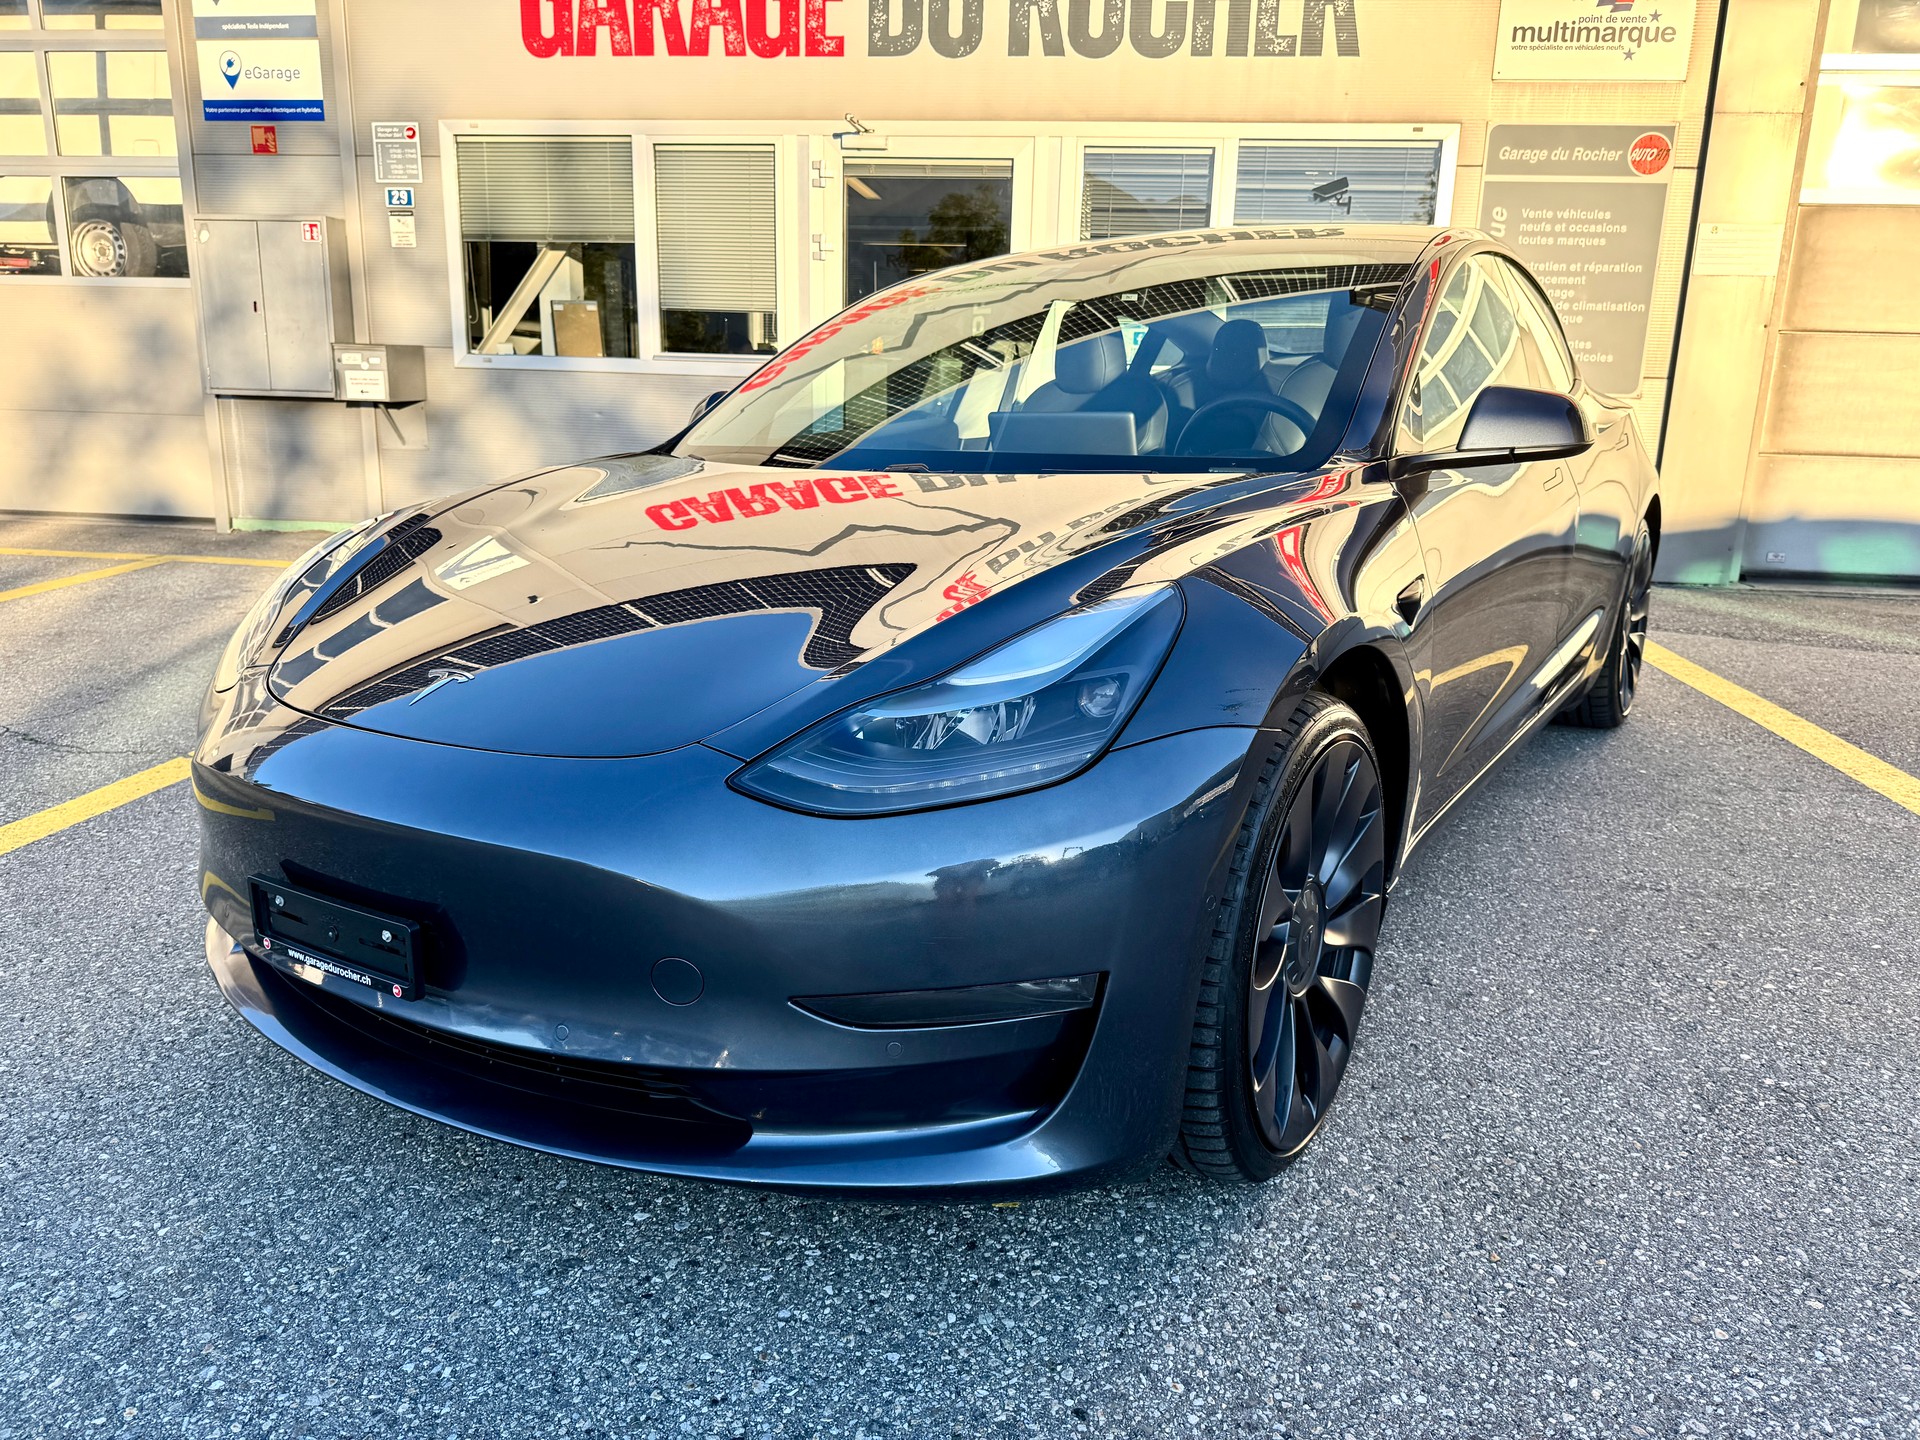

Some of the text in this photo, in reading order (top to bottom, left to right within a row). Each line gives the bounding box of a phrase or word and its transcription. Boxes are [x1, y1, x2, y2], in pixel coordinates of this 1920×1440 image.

[1578, 14, 1648, 25] point de vente
[1512, 20, 1677, 48] multimarque
[245, 66, 300, 82] eGarage
[1499, 146, 1548, 164] Garage
[1551, 147, 1568, 161] du
[1572, 147, 1623, 161] Rocher
[391, 190, 408, 205] 29
[1521, 208, 1611, 219] Vente véhicules
[1490, 206, 1507, 238] ue
[1520, 222, 1627, 233] neufs et occasions
[1518, 235, 1606, 248] toutes marques
[1528, 261, 1642, 274] tretien et réparation
[1538, 276, 1586, 285] ncement
[1548, 289, 1575, 299] nage
[1556, 301, 1645, 312] de climatisation
[1560, 313, 1583, 325] ique
[1568, 340, 1592, 349] ntes
[1574, 353, 1614, 363] ricoles
[288, 948, 372, 986] www.garagedurocher.ch
